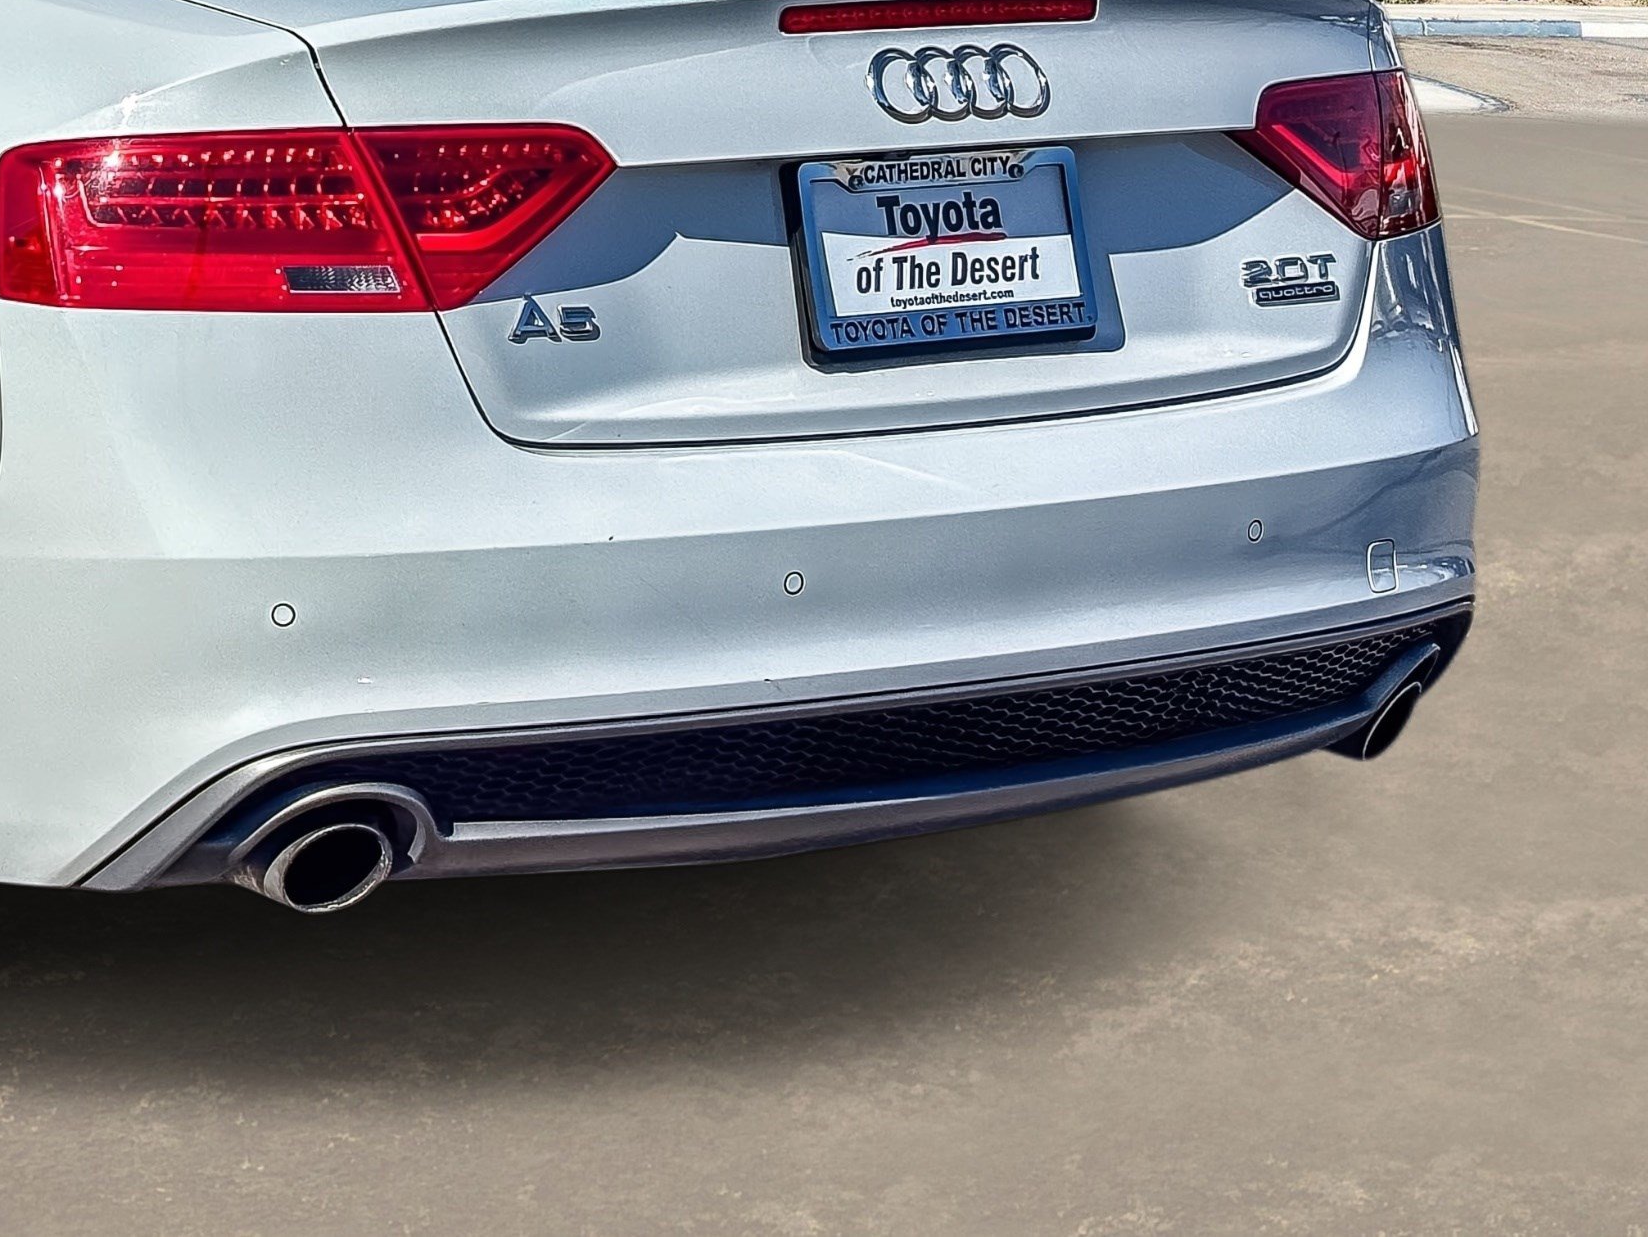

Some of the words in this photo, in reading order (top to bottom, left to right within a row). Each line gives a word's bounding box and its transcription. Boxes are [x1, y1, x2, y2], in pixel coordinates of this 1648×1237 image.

[863, 158, 966, 185] CATHEDRAL
[970, 155, 1010, 178] CITY
[876, 191, 1003, 244] Toyota
[856, 257, 884, 294] of
[892, 255, 940, 291] The
[952, 246, 1039, 285] Desert
[890, 289, 1014, 308] toyotaofthedesert.com
[1259, 284, 1333, 300] quattro
[508, 292, 601, 344] A5
[829, 317, 915, 345] TOYOTA
[920, 313, 948, 336] OF
[955, 308, 999, 332] THE
[1005, 302, 1086, 329] DESERT
